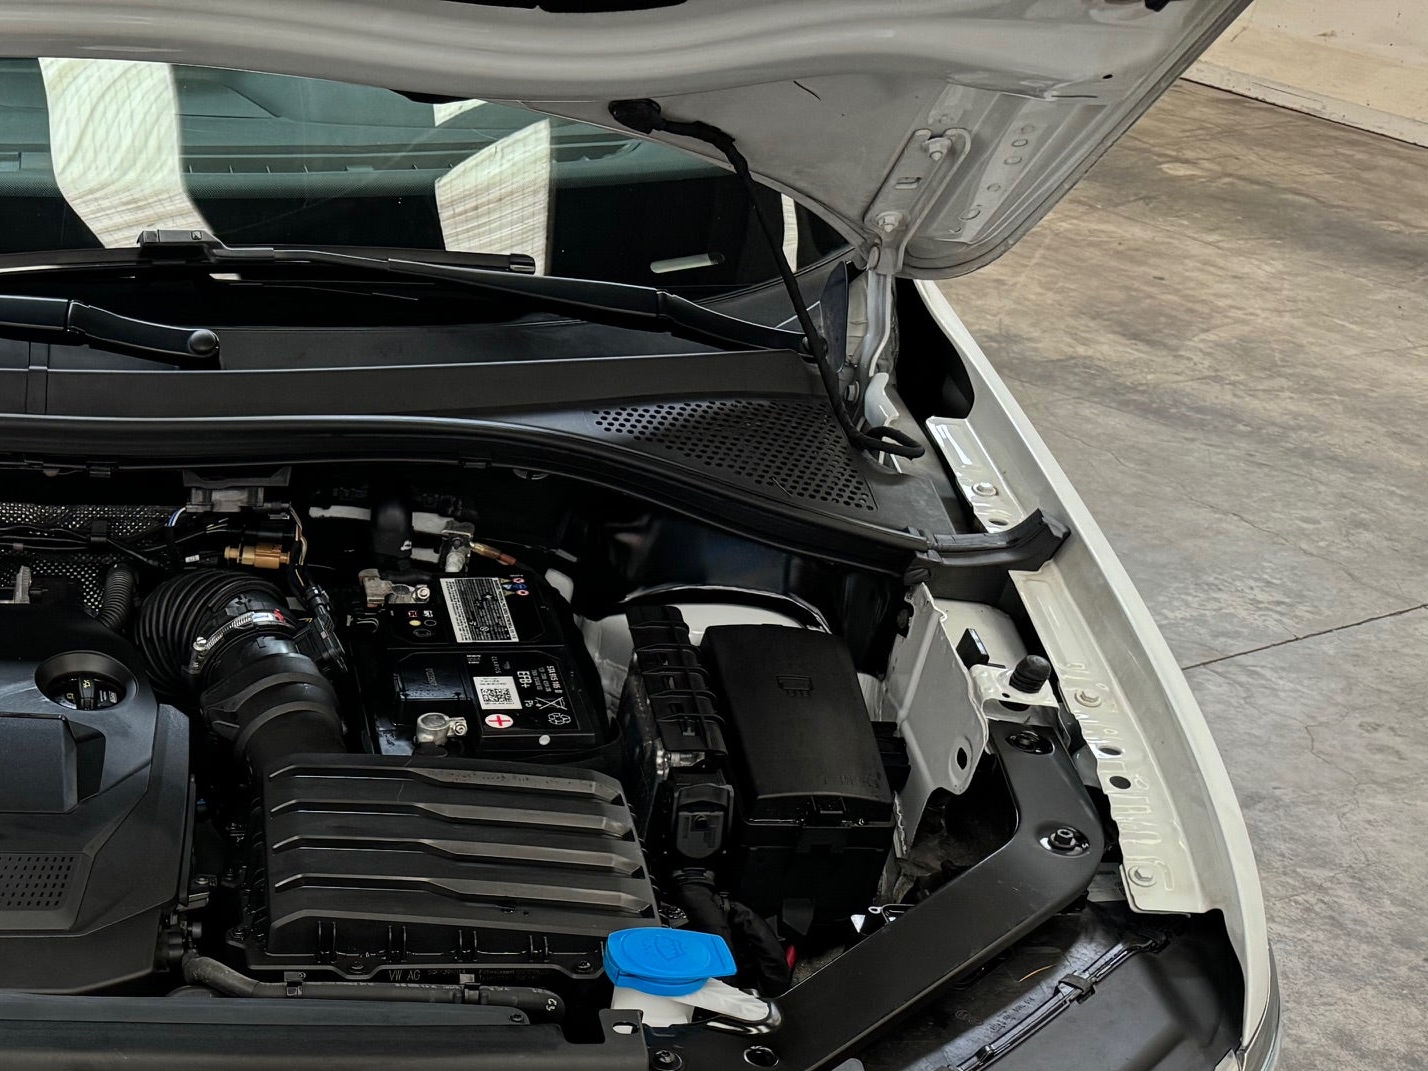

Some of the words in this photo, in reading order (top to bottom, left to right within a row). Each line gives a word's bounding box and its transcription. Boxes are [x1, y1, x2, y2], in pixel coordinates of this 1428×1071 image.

[517, 670, 532, 688] EFB+
[388, 970, 402, 981] VW
[407, 970, 421, 981] AG
